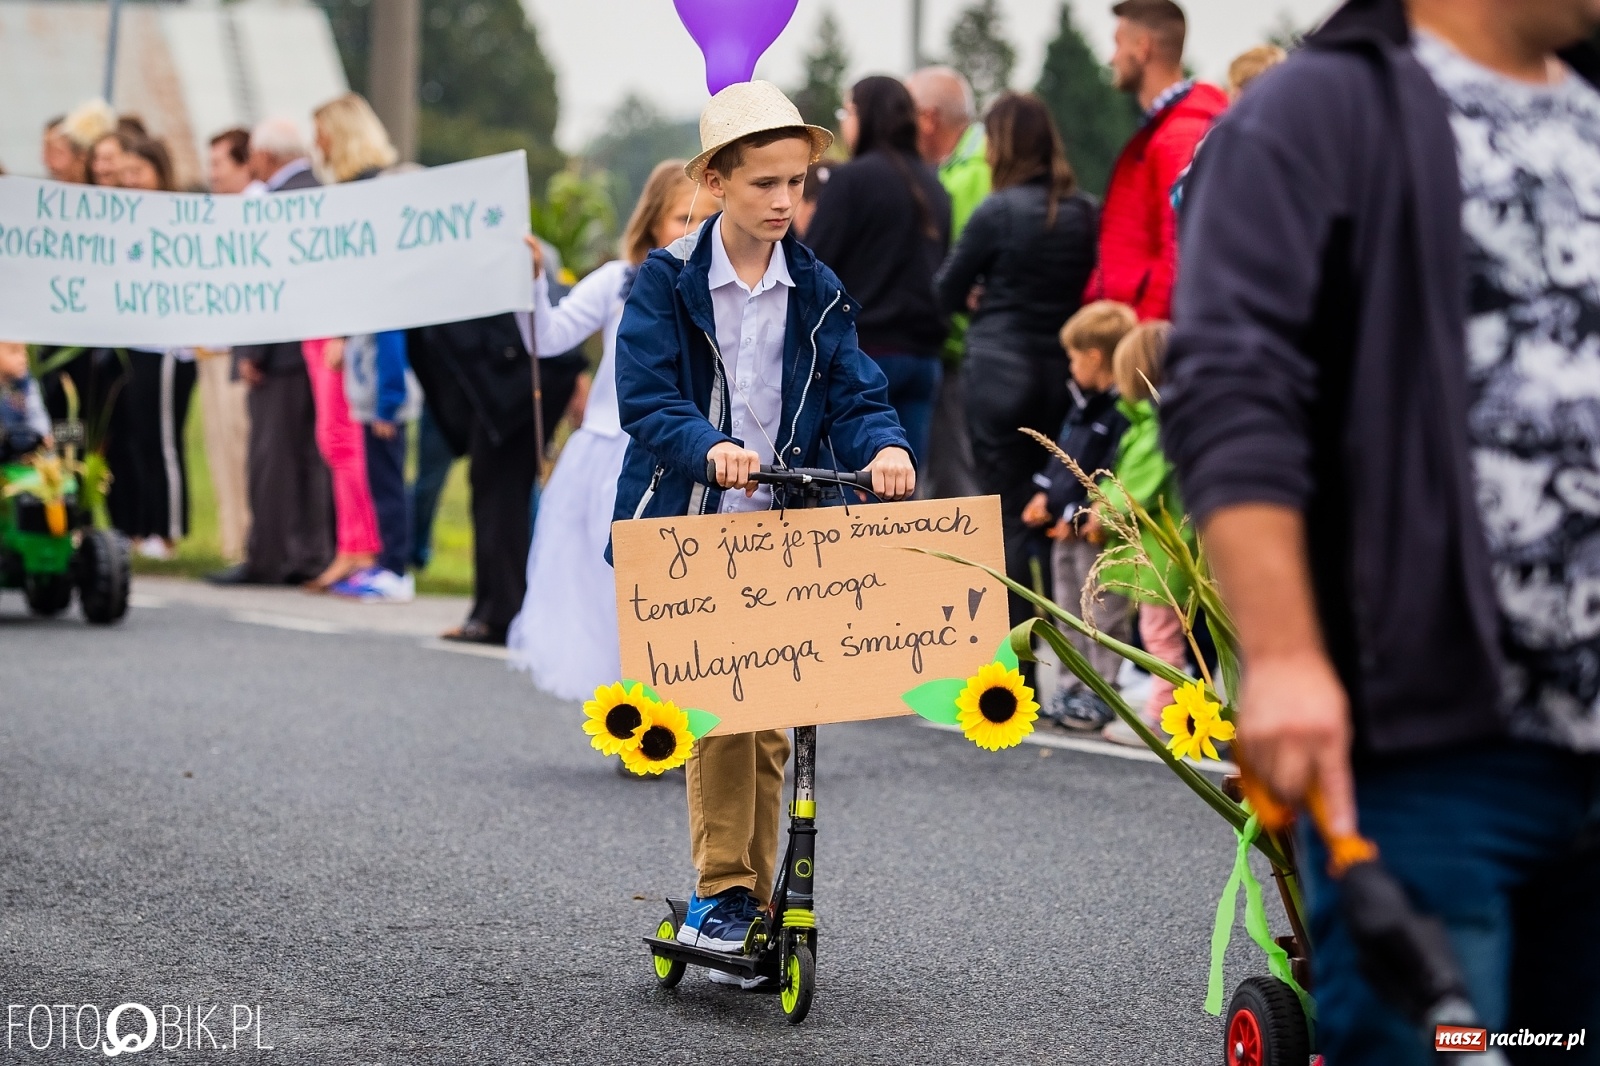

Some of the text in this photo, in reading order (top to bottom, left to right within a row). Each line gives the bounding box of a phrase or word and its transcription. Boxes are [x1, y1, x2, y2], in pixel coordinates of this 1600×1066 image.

[37, 186, 326, 226] KLAJDY JUŻ MOMY
[0, 223, 115, 266] OGRAMU
[150, 226, 272, 271] ROLNIK
[288, 220, 378, 265] SZUKA
[49, 275, 286, 317] SE WYBIEROMY
[659, 526, 699, 580] Jo
[717, 519, 774, 580] już
[807, 528, 841, 568] po
[850, 507, 979, 540] żniwach
[630, 572, 887, 622] teraz se moga
[647, 639, 825, 702] hulajnogą
